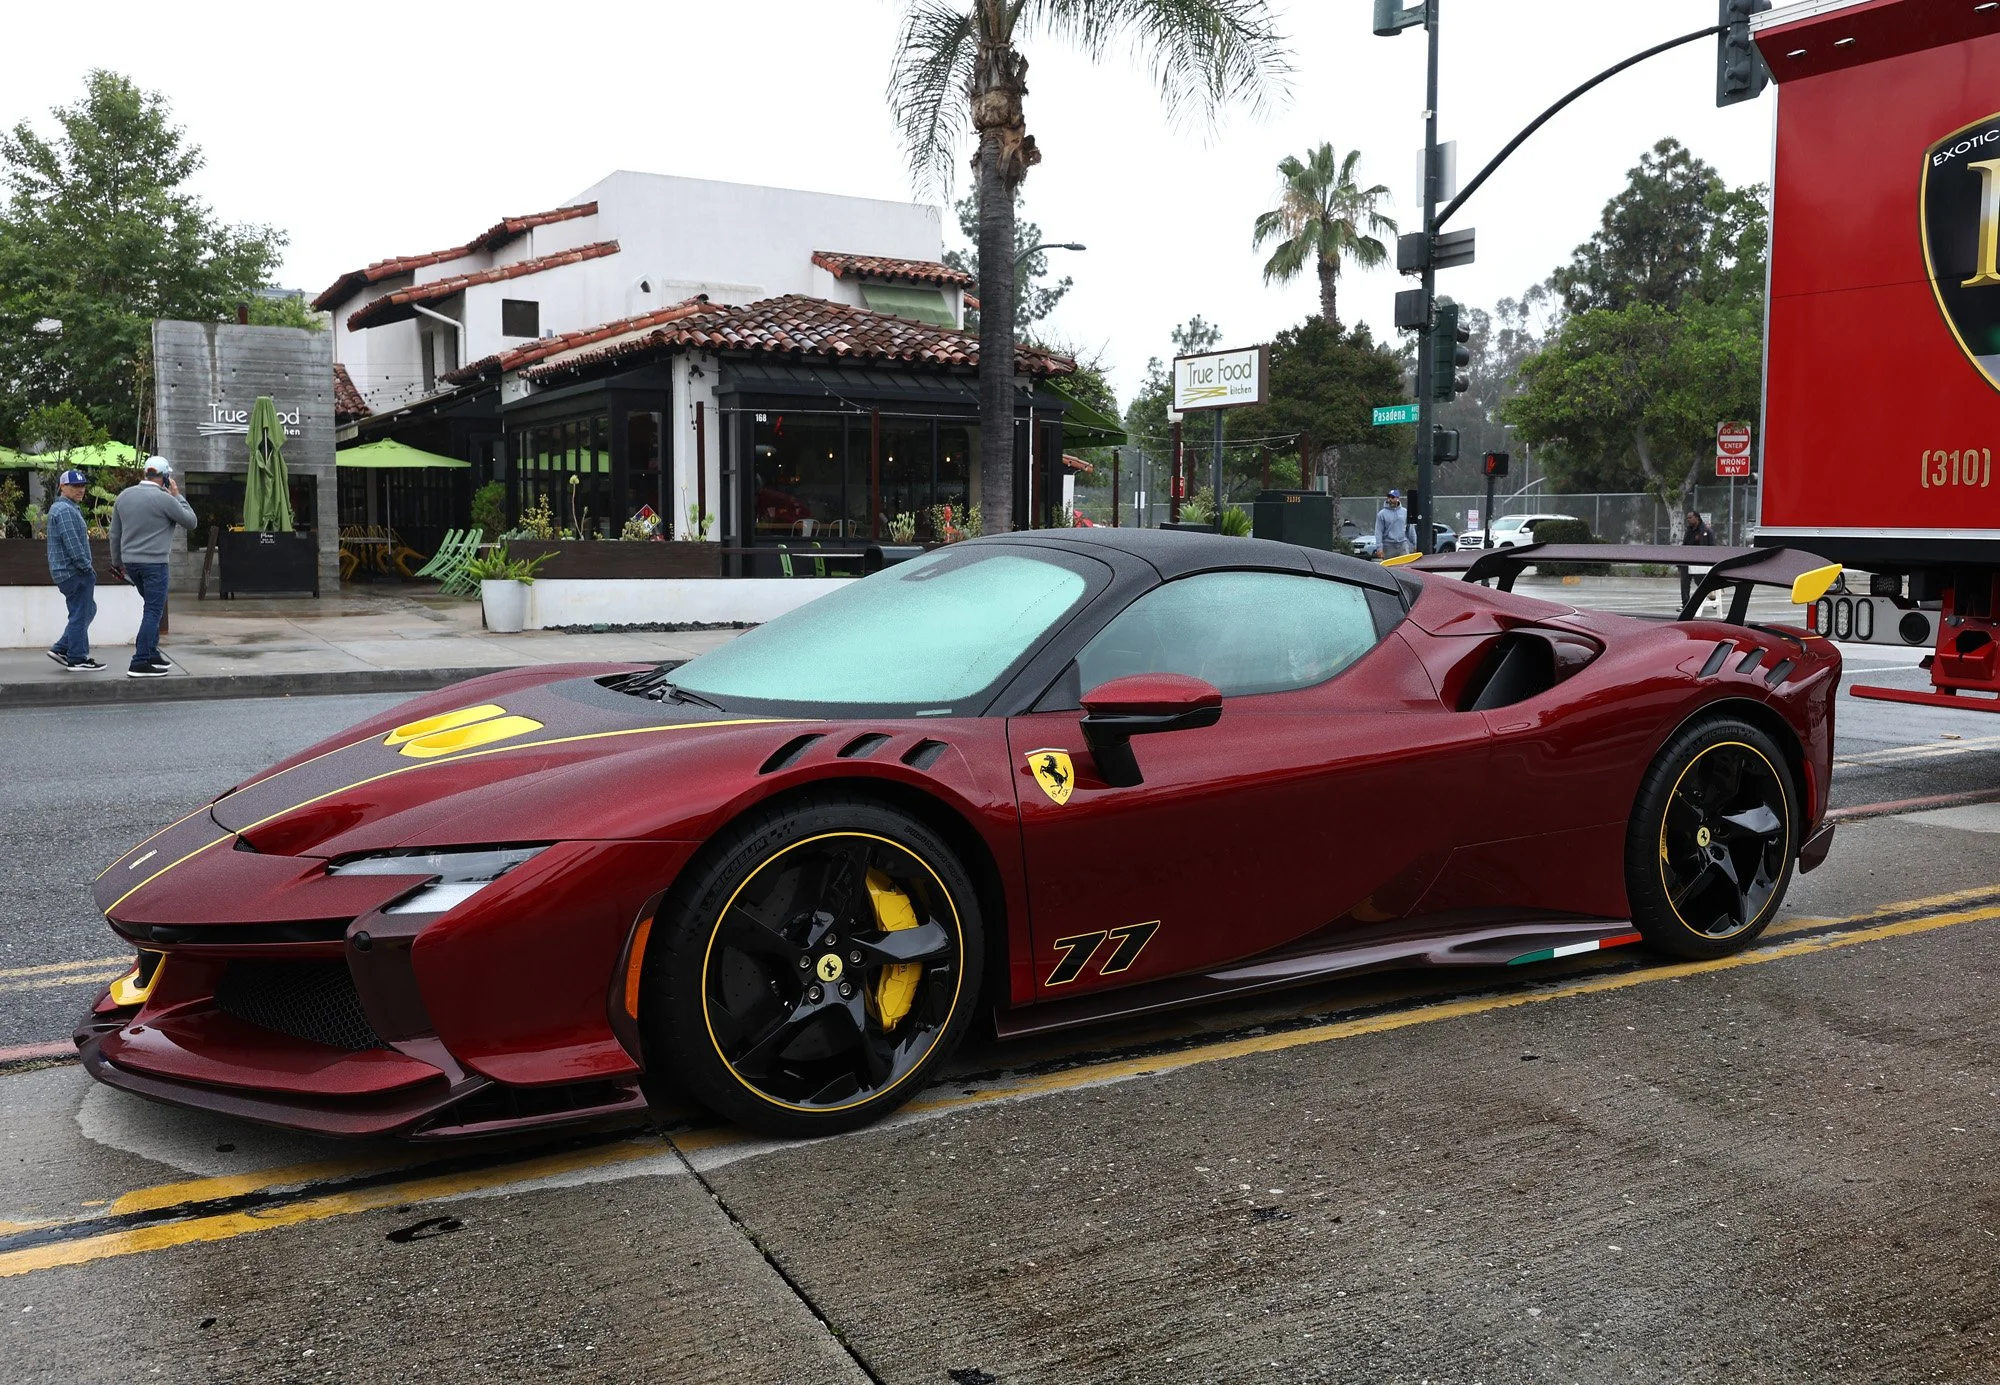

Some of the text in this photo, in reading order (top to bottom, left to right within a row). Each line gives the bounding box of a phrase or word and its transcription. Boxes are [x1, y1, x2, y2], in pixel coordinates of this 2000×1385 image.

[1186, 354, 1252, 388] True Food
[1230, 384, 1252, 395] kitchen
[208, 403, 248, 424] True
[755, 413, 767, 422] 168
[1373, 409, 1406, 422] Pasadena
[1720, 458, 1746, 466] WRONG
[1921, 448, 1991, 488] (310)
[709, 836, 769, 895] MICHELIN
[1044, 919, 1161, 987] 77
